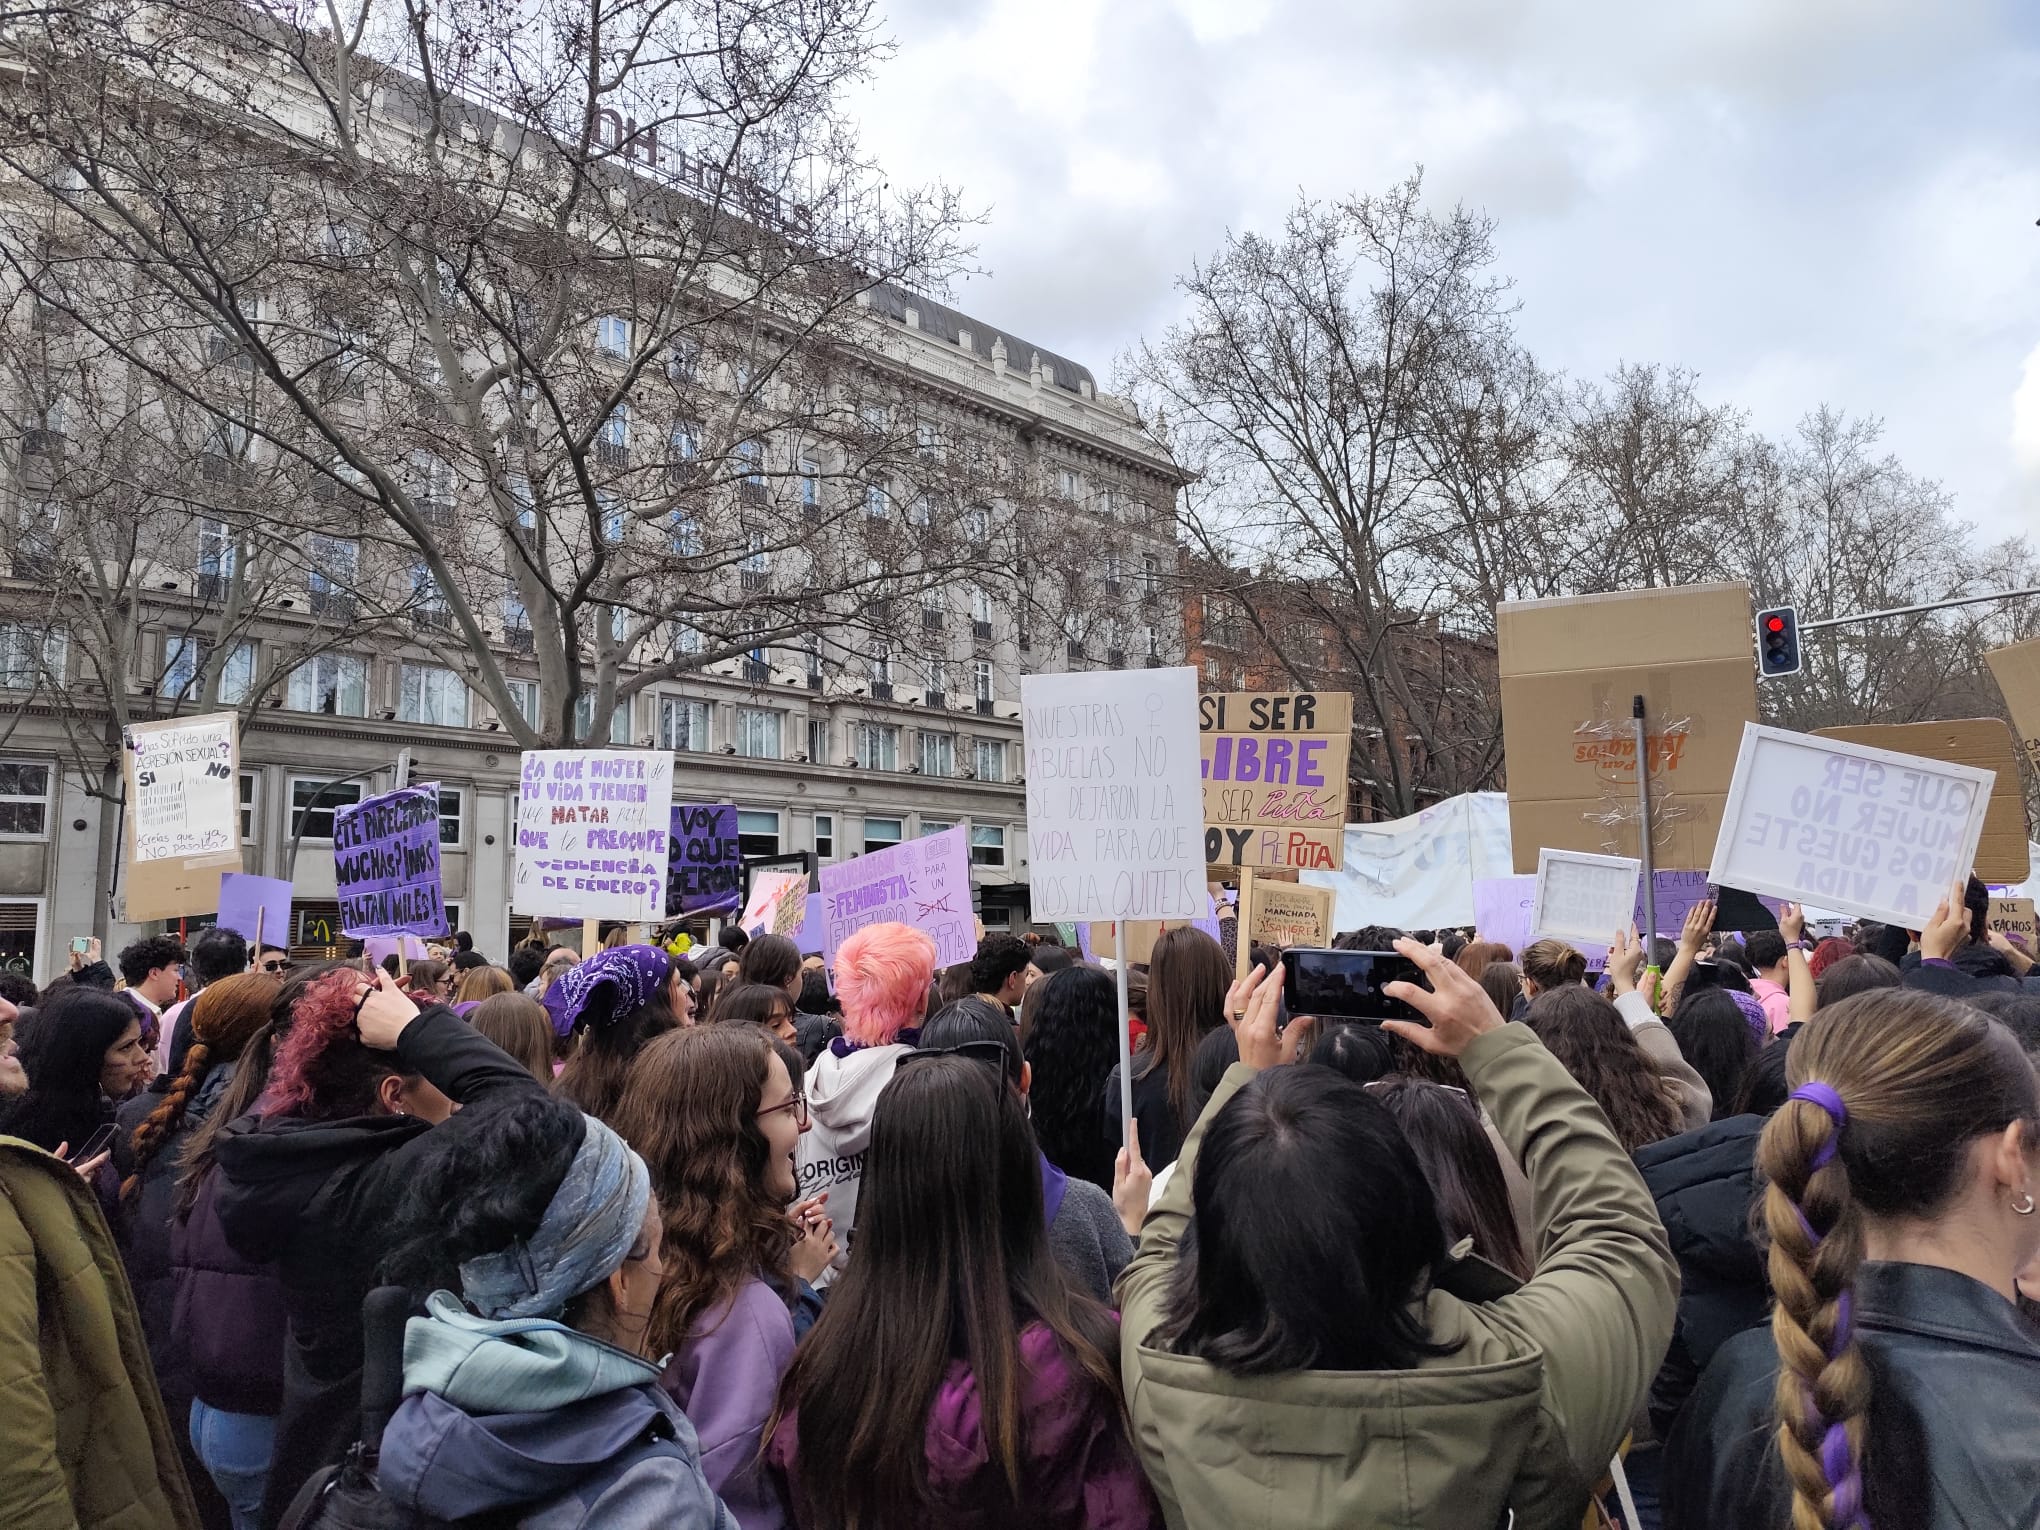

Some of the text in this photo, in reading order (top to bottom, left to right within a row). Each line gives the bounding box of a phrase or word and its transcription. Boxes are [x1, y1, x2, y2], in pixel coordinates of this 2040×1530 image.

[1028, 703, 1125, 739] NUESTRAS
[1248, 694, 1317, 731] SER
[553, 755, 587, 781] QUÉ
[590, 758, 646, 780] MUJER
[650, 757, 666, 781] de
[1029, 735, 1167, 780] ABUELAS NO
[138, 761, 231, 787] SI NO
[588, 782, 648, 803] TIENEN
[1030, 788, 1052, 819] SE
[1068, 784, 1140, 821] DEJARON
[1150, 784, 1175, 821] LA
[1217, 789, 1254, 822] SER
[1257, 789, 1344, 821] Puta
[520, 805, 544, 827] que
[551, 805, 609, 825] MATAR
[678, 806, 726, 838] VOY
[176, 833, 195, 845] que
[519, 828, 549, 850] QUE
[586, 828, 666, 854] PREOCUPE
[685, 836, 739, 865] QUE
[1031, 826, 1189, 862] VIDA PARA QUE
[145, 846, 168, 859] NO
[924, 862, 947, 876] PARA
[1685, 871, 1705, 887] LAS
[542, 876, 569, 891] DE
[835, 874, 910, 918] FEMINISTA
[931, 877, 945, 890] UN
[1033, 869, 1197, 917] NOS LA QUITEIS
[340, 892, 390, 930] FALTAN
[1264, 907, 1317, 919] MANCHADA
[1999, 902, 2018, 914] NI
[1268, 923, 1313, 937] SANGRE
[1992, 918, 2033, 932] FACHOS
[926, 920, 969, 964] STA
